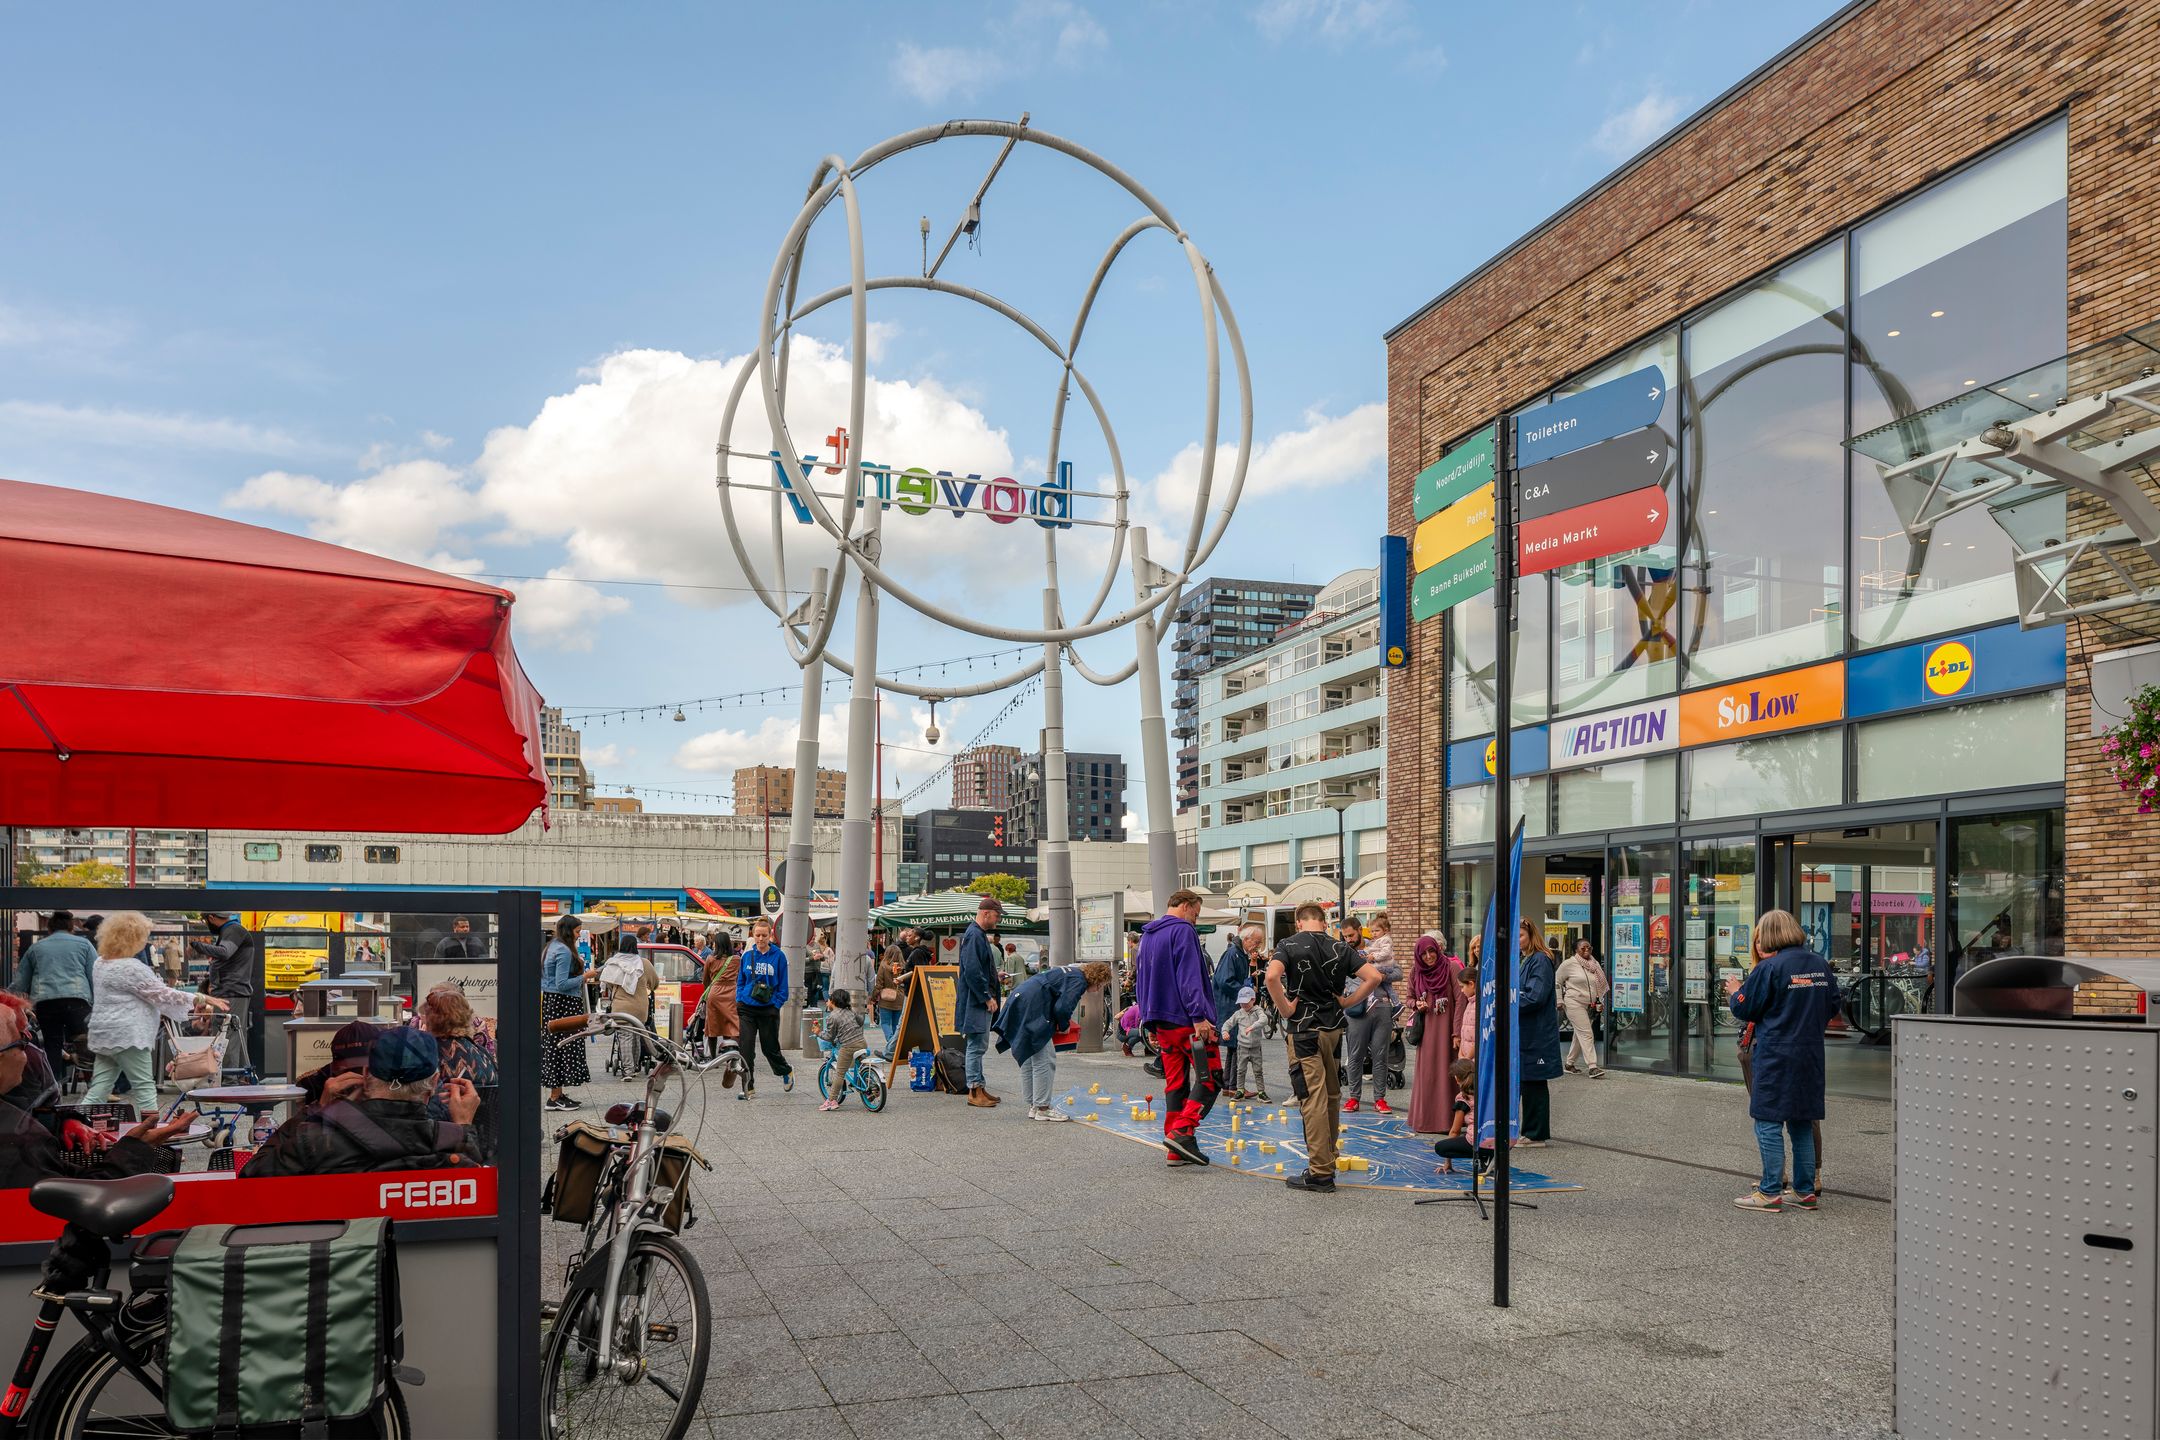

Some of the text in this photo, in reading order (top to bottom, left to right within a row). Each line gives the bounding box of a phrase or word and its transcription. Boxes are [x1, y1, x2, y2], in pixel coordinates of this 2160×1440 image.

[1526, 418, 1577, 443] Toiletten
[1435, 453, 1485, 490] Noord/Zuidlijn
[1525, 484, 1550, 500] C&A
[1525, 526, 1599, 555] Media Markt
[1430, 560, 1487, 596] Banne Buiksloot
[1573, 709, 1667, 756] ACTION
[910, 914, 977, 925] BLOEMENHAN
[380, 1178, 477, 1209] FEBO
